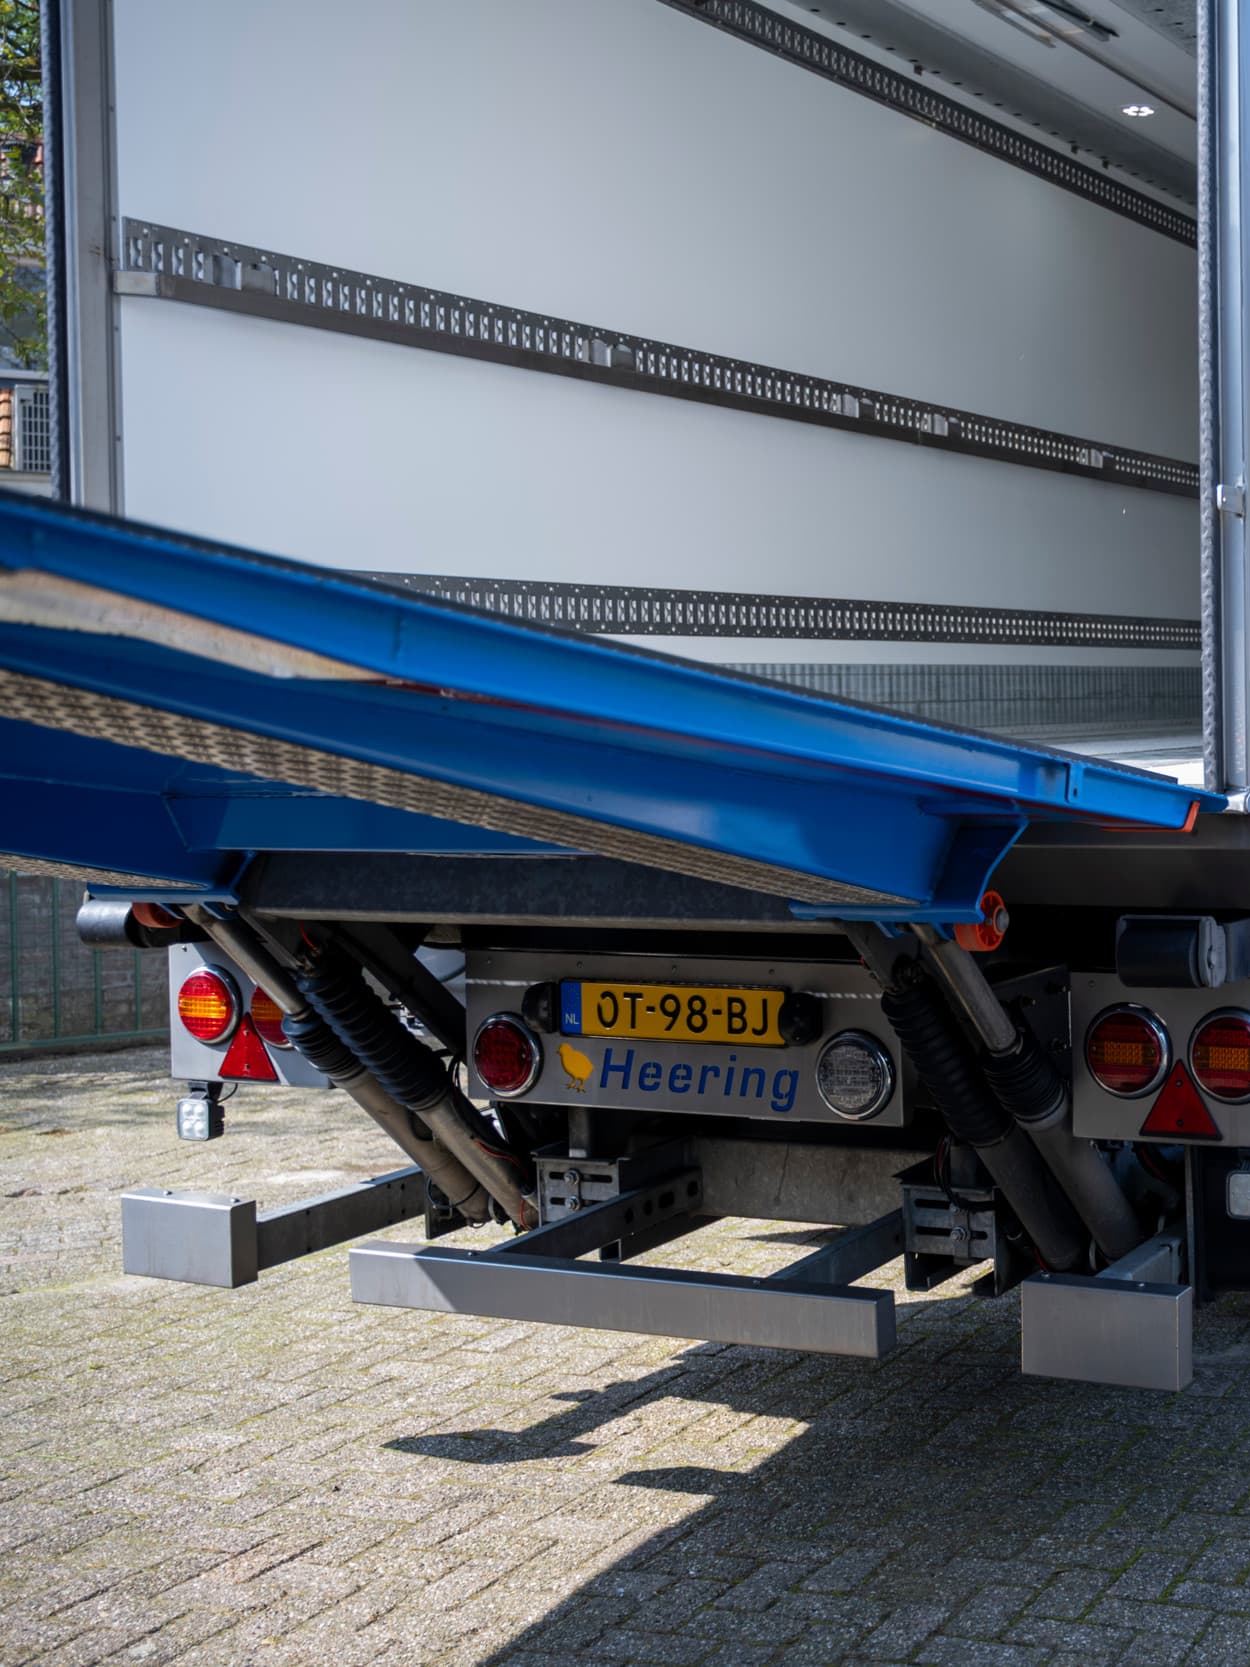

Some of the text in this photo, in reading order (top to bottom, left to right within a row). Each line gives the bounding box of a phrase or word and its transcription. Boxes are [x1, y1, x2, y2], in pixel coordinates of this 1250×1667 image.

[565, 1012, 580, 1025] NL
[596, 990, 769, 1037] OT-98-BJ
[600, 1047, 799, 1113] Heering
